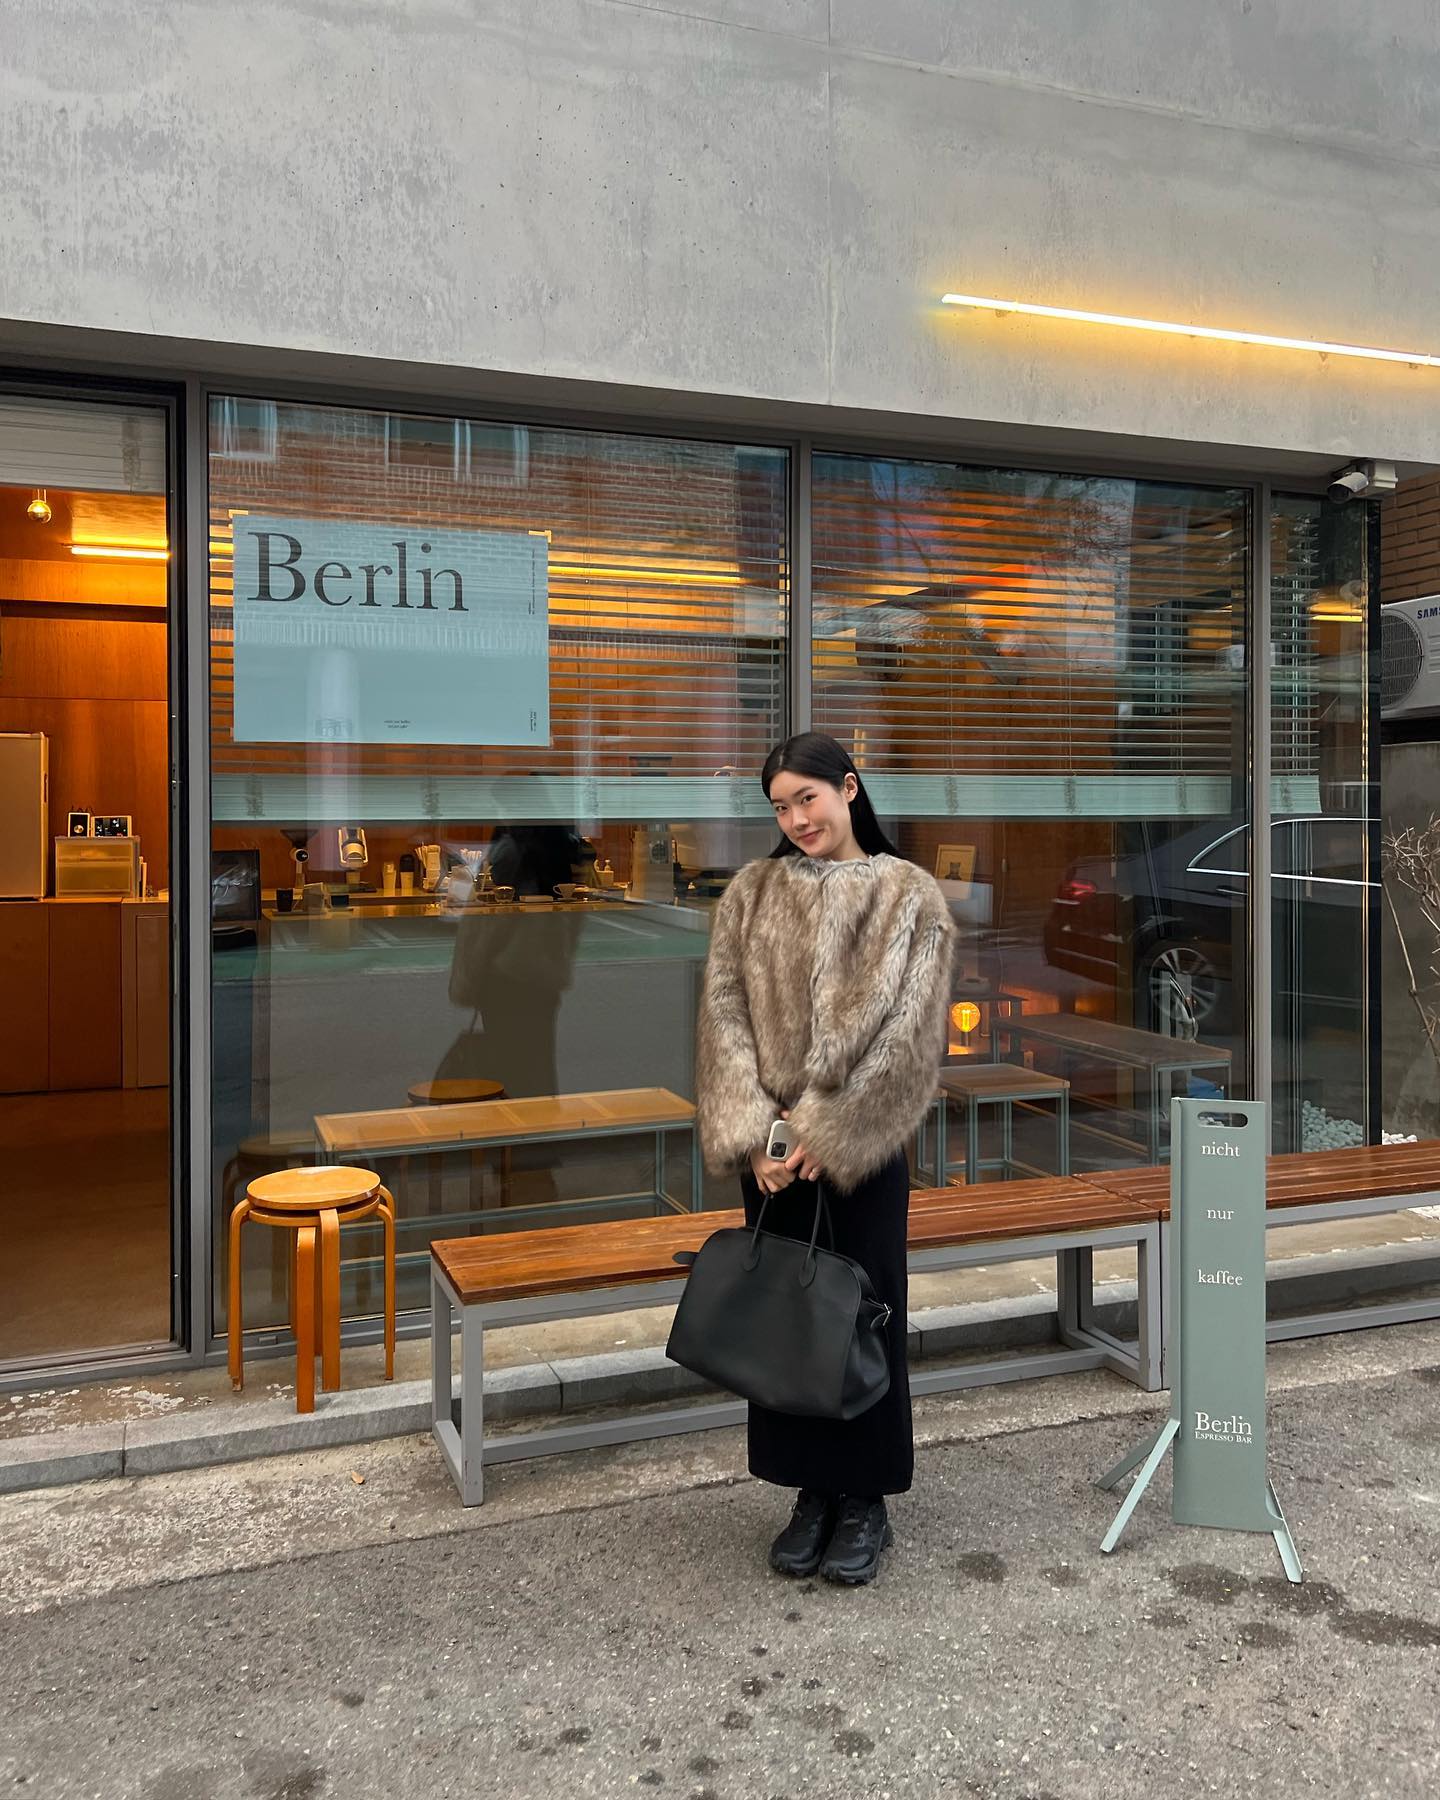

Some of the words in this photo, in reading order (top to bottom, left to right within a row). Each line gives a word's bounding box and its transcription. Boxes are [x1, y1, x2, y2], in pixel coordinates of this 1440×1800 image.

[247, 532, 469, 611] Berlin
[1201, 1141, 1240, 1157] nicht
[1207, 1209, 1234, 1220] nur
[1198, 1269, 1243, 1286] kaffee
[1195, 1412, 1252, 1435] Berlin
[1195, 1431, 1233, 1442] ESPRESSO
[1236, 1435, 1252, 1444] BAR
